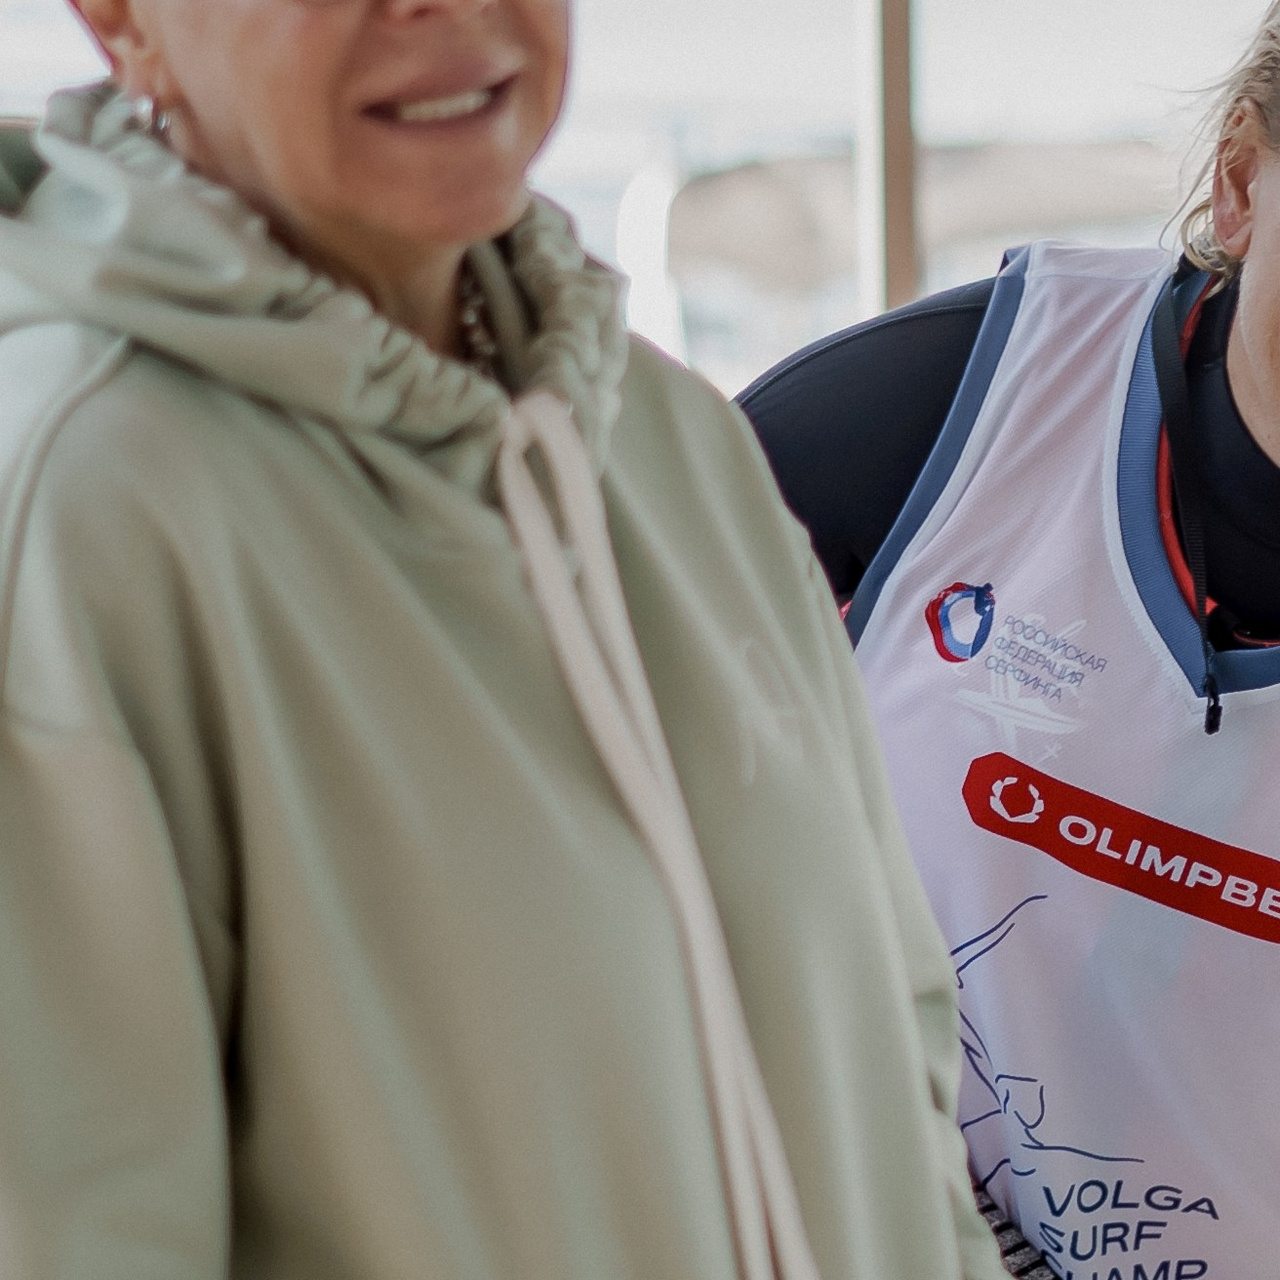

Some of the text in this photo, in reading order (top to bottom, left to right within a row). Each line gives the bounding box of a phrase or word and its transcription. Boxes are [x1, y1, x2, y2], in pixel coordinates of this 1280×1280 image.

[994, 636, 1085, 687] ФЕДЕРАЦИЯ
[1003, 615, 1108, 672] РОССИЙСКАЯ
[985, 655, 1063, 702] СЕРФИНГА
[1042, 1179, 1220, 1221] VOLGA
[1039, 1221, 1168, 1261] SURF
